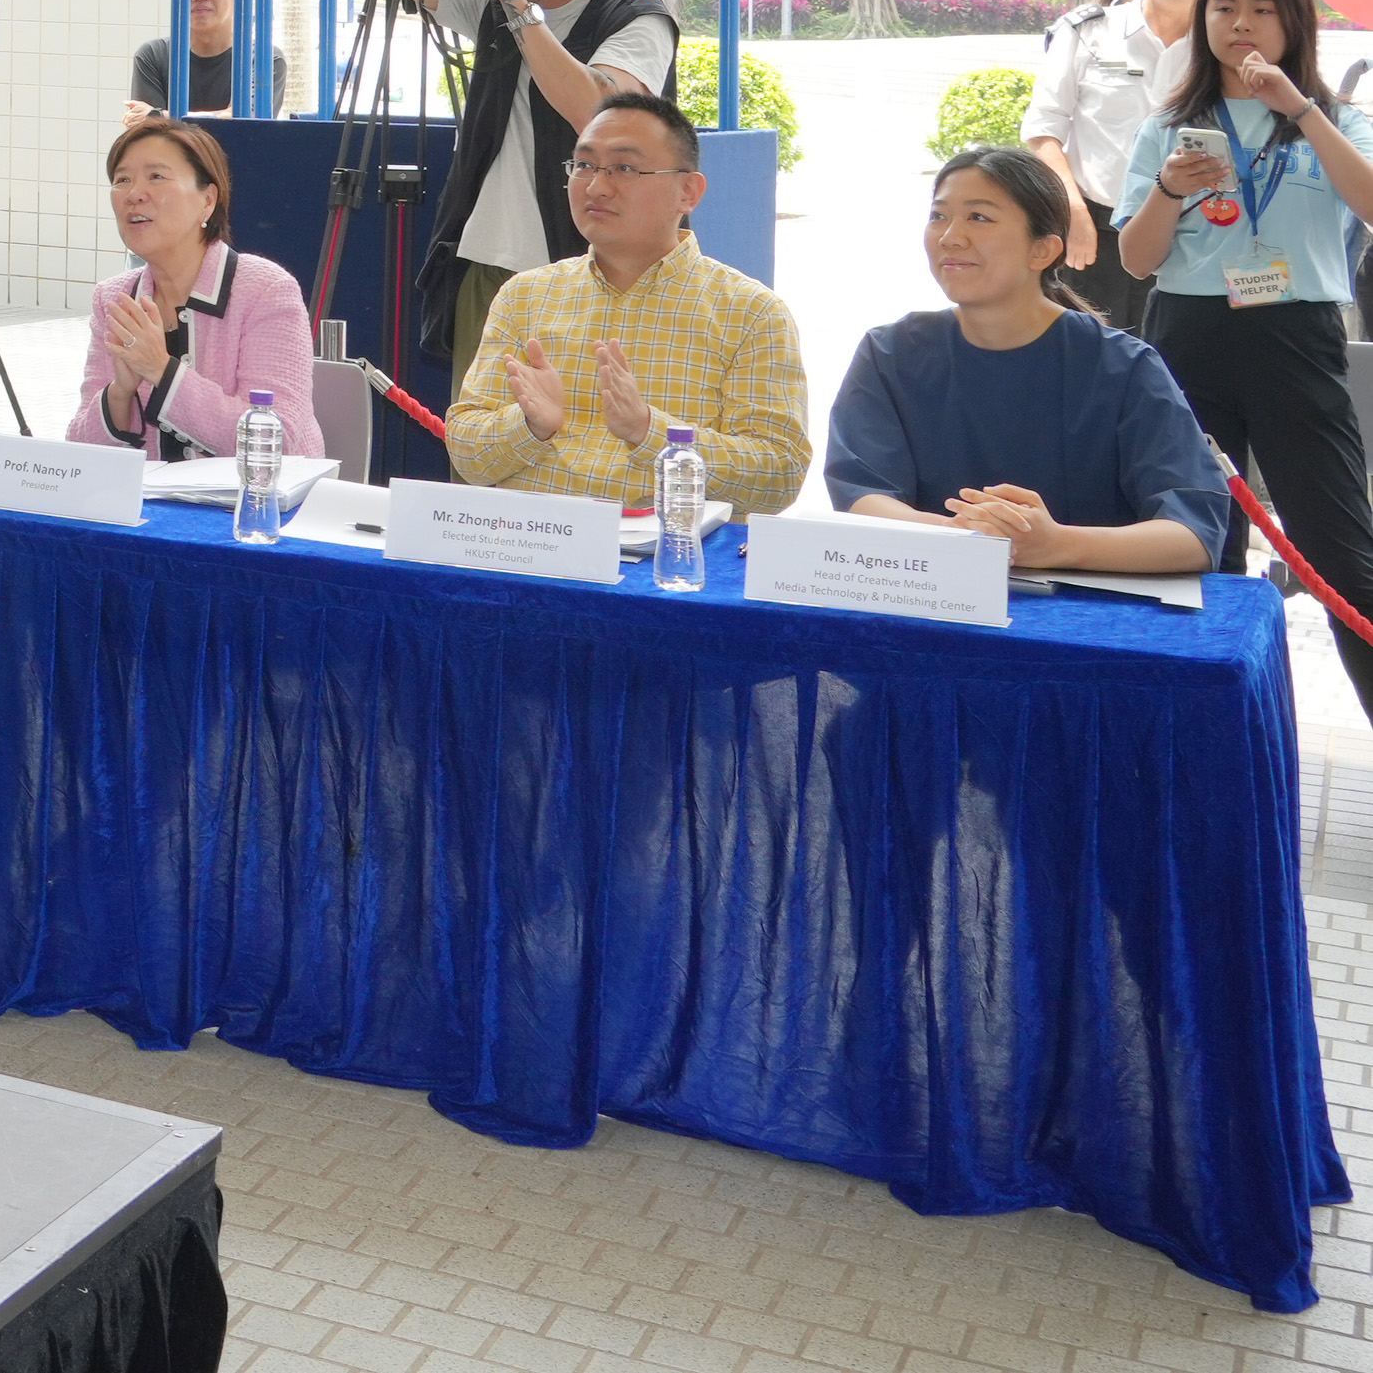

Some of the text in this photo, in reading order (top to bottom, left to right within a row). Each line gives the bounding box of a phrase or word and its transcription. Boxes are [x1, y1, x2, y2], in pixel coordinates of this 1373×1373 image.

[1233, 273, 1280, 286] STUDENT
[1240, 284, 1279, 296] HELPER
[4, 460, 81, 479] Prof. Nancy IP
[21, 479, 59, 492] President
[432, 510, 573, 536] Mr. Zhonghua SHENG
[442, 530, 559, 552] Elected Student Member
[465, 549, 533, 564] HKUST Council
[824, 550, 928, 572] Ms. Agnes LEE
[814, 569, 937, 592] Head of Creative Media
[774, 581, 977, 613] Media Technology & Publishing Center
